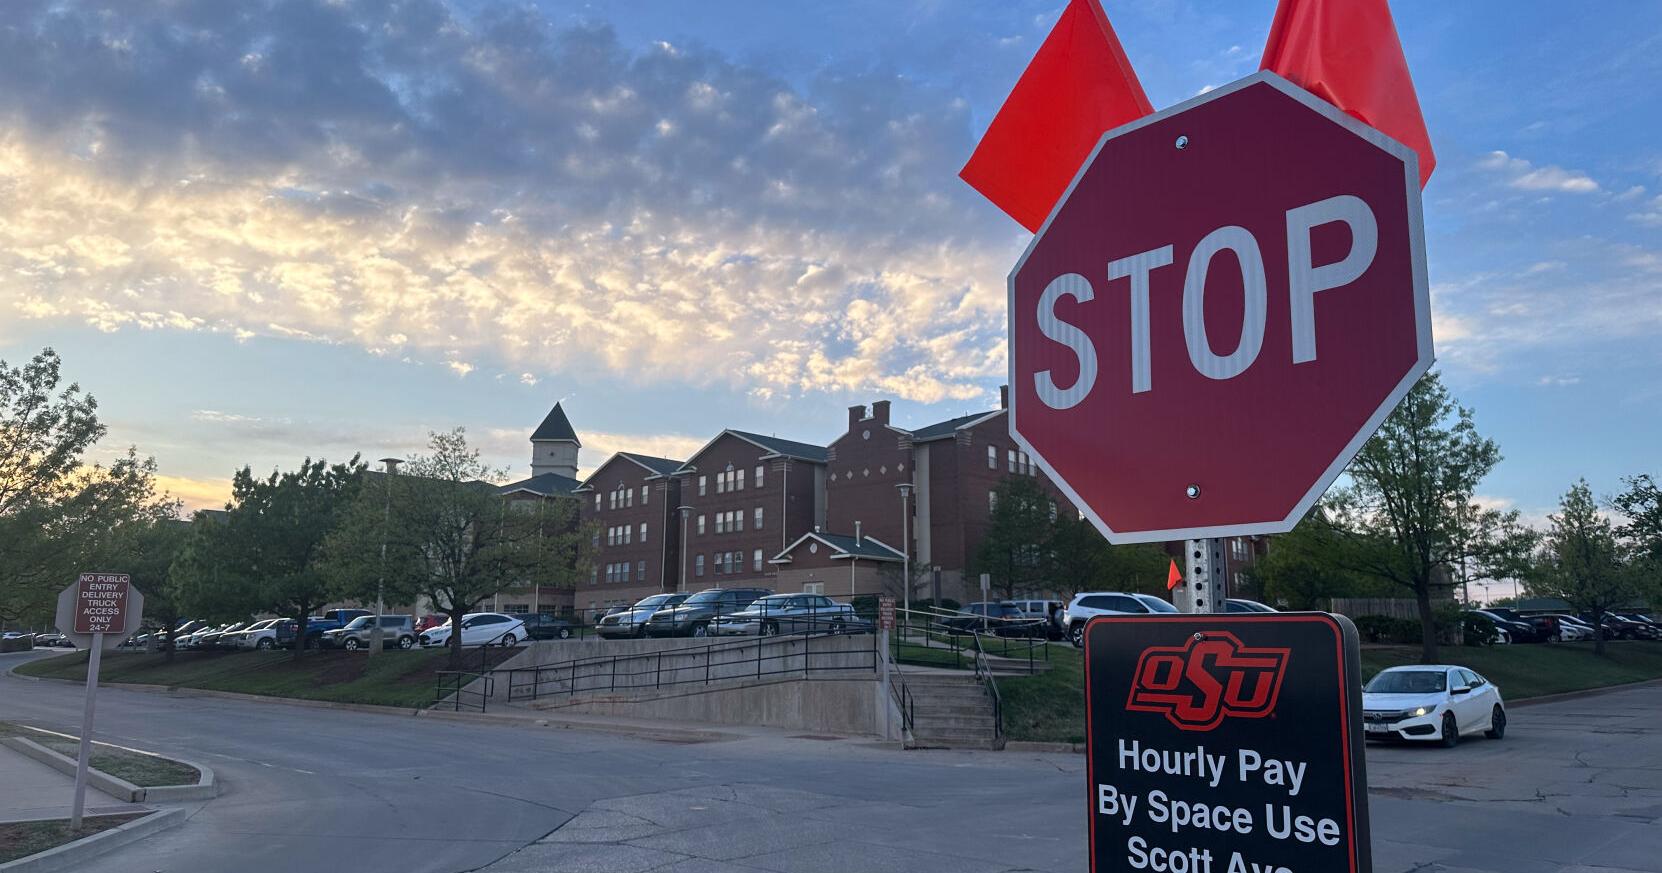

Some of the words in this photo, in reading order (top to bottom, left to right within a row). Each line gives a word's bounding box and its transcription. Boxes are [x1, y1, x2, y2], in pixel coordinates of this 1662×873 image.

[1034, 194, 1378, 410] STOP
[82, 591, 124, 599] DELIVERY
[88, 599, 117, 607] TRUCK
[97, 575, 128, 583] PUBLIC
[1134, 639, 1280, 724] OSU
[1118, 738, 1226, 788] Hourly
[1238, 748, 1307, 796] Pay
[1098, 783, 1138, 826] By
[1147, 789, 1254, 834] Space
[1265, 803, 1341, 846] Use
[1127, 835, 1214, 873] Scott
